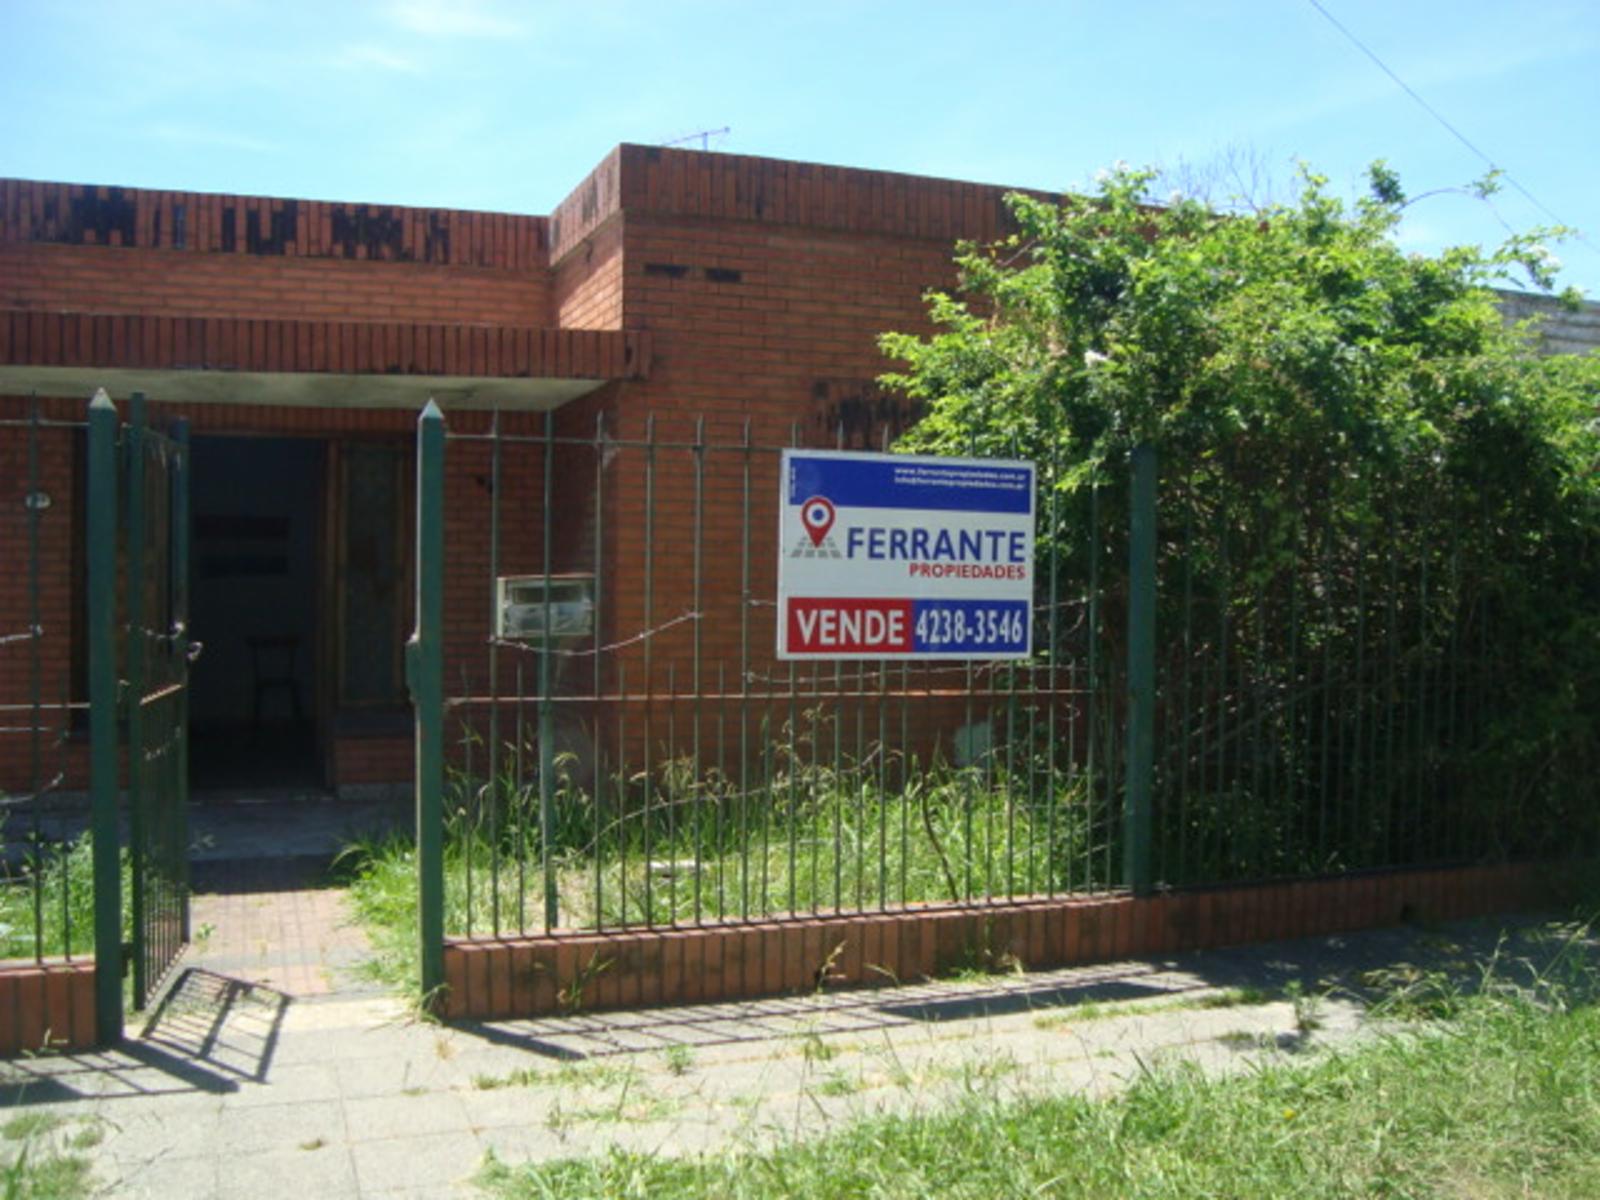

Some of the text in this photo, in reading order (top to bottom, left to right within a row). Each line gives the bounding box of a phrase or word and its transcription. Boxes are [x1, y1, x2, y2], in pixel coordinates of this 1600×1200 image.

[847, 527, 1026, 562] FERRANTE
[909, 563, 1026, 580] PROPIEDADES
[796, 608, 1023, 645] VENDE 4238-3546
